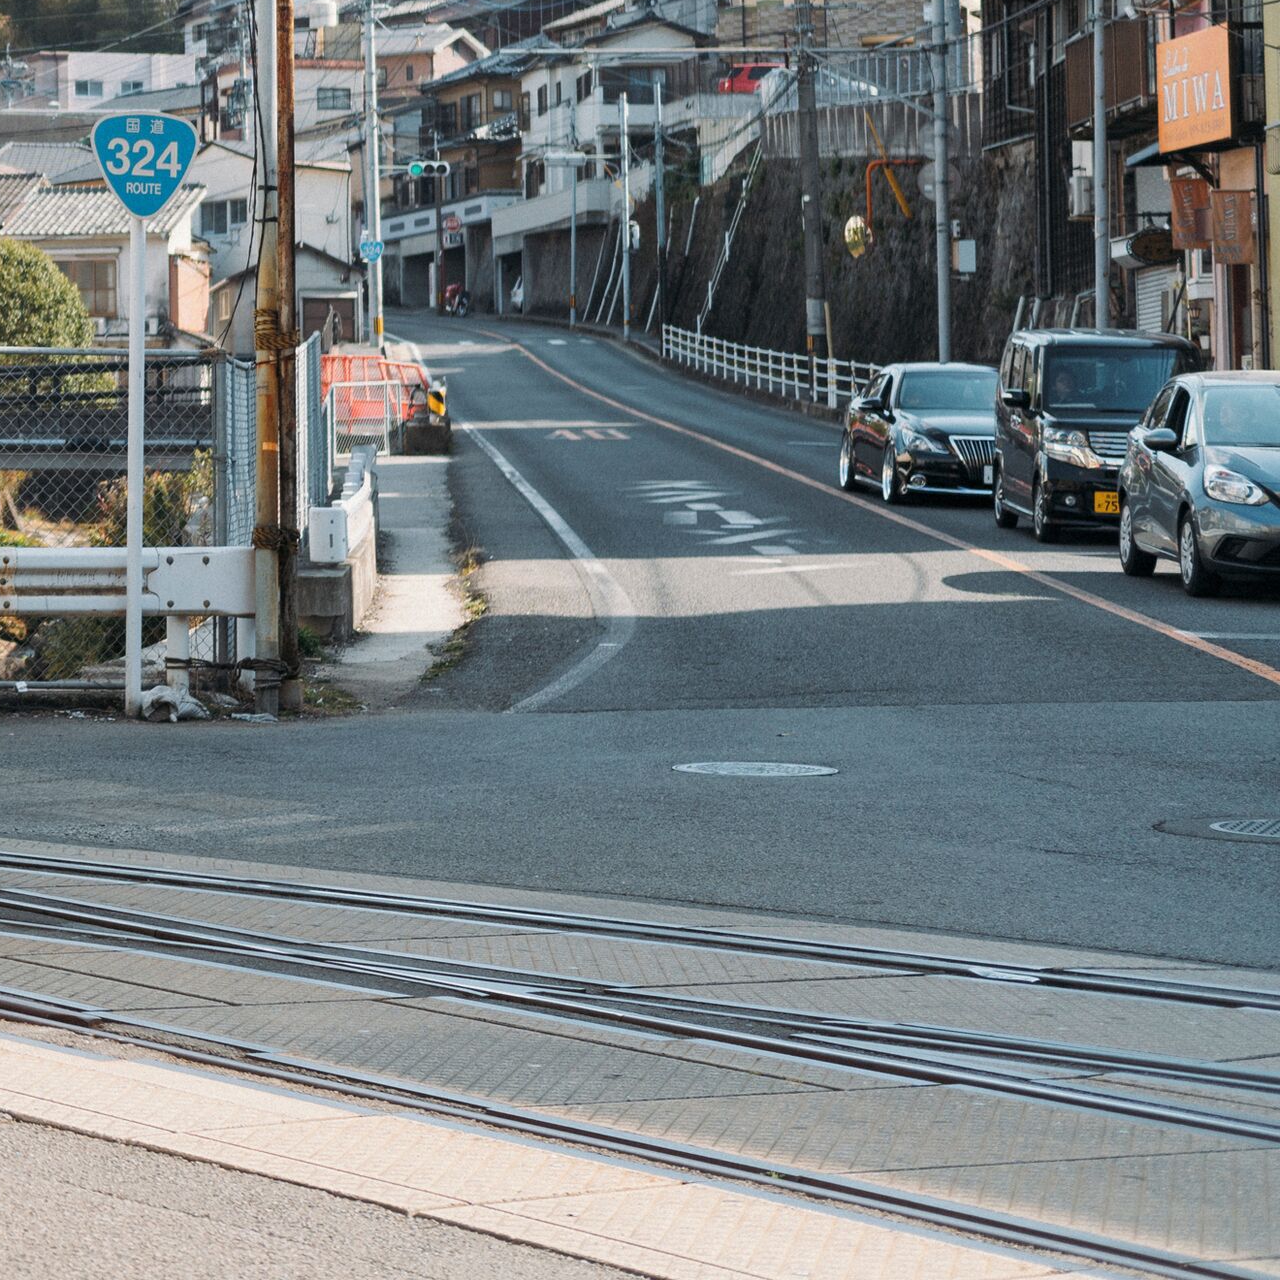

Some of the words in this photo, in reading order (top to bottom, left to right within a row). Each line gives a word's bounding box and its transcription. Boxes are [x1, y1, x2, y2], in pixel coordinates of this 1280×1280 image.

[1163, 67, 1225, 123] MIWA
[126, 118, 164, 134] 国道
[106, 137, 182, 178] 324
[126, 182, 161, 195] ROUTE
